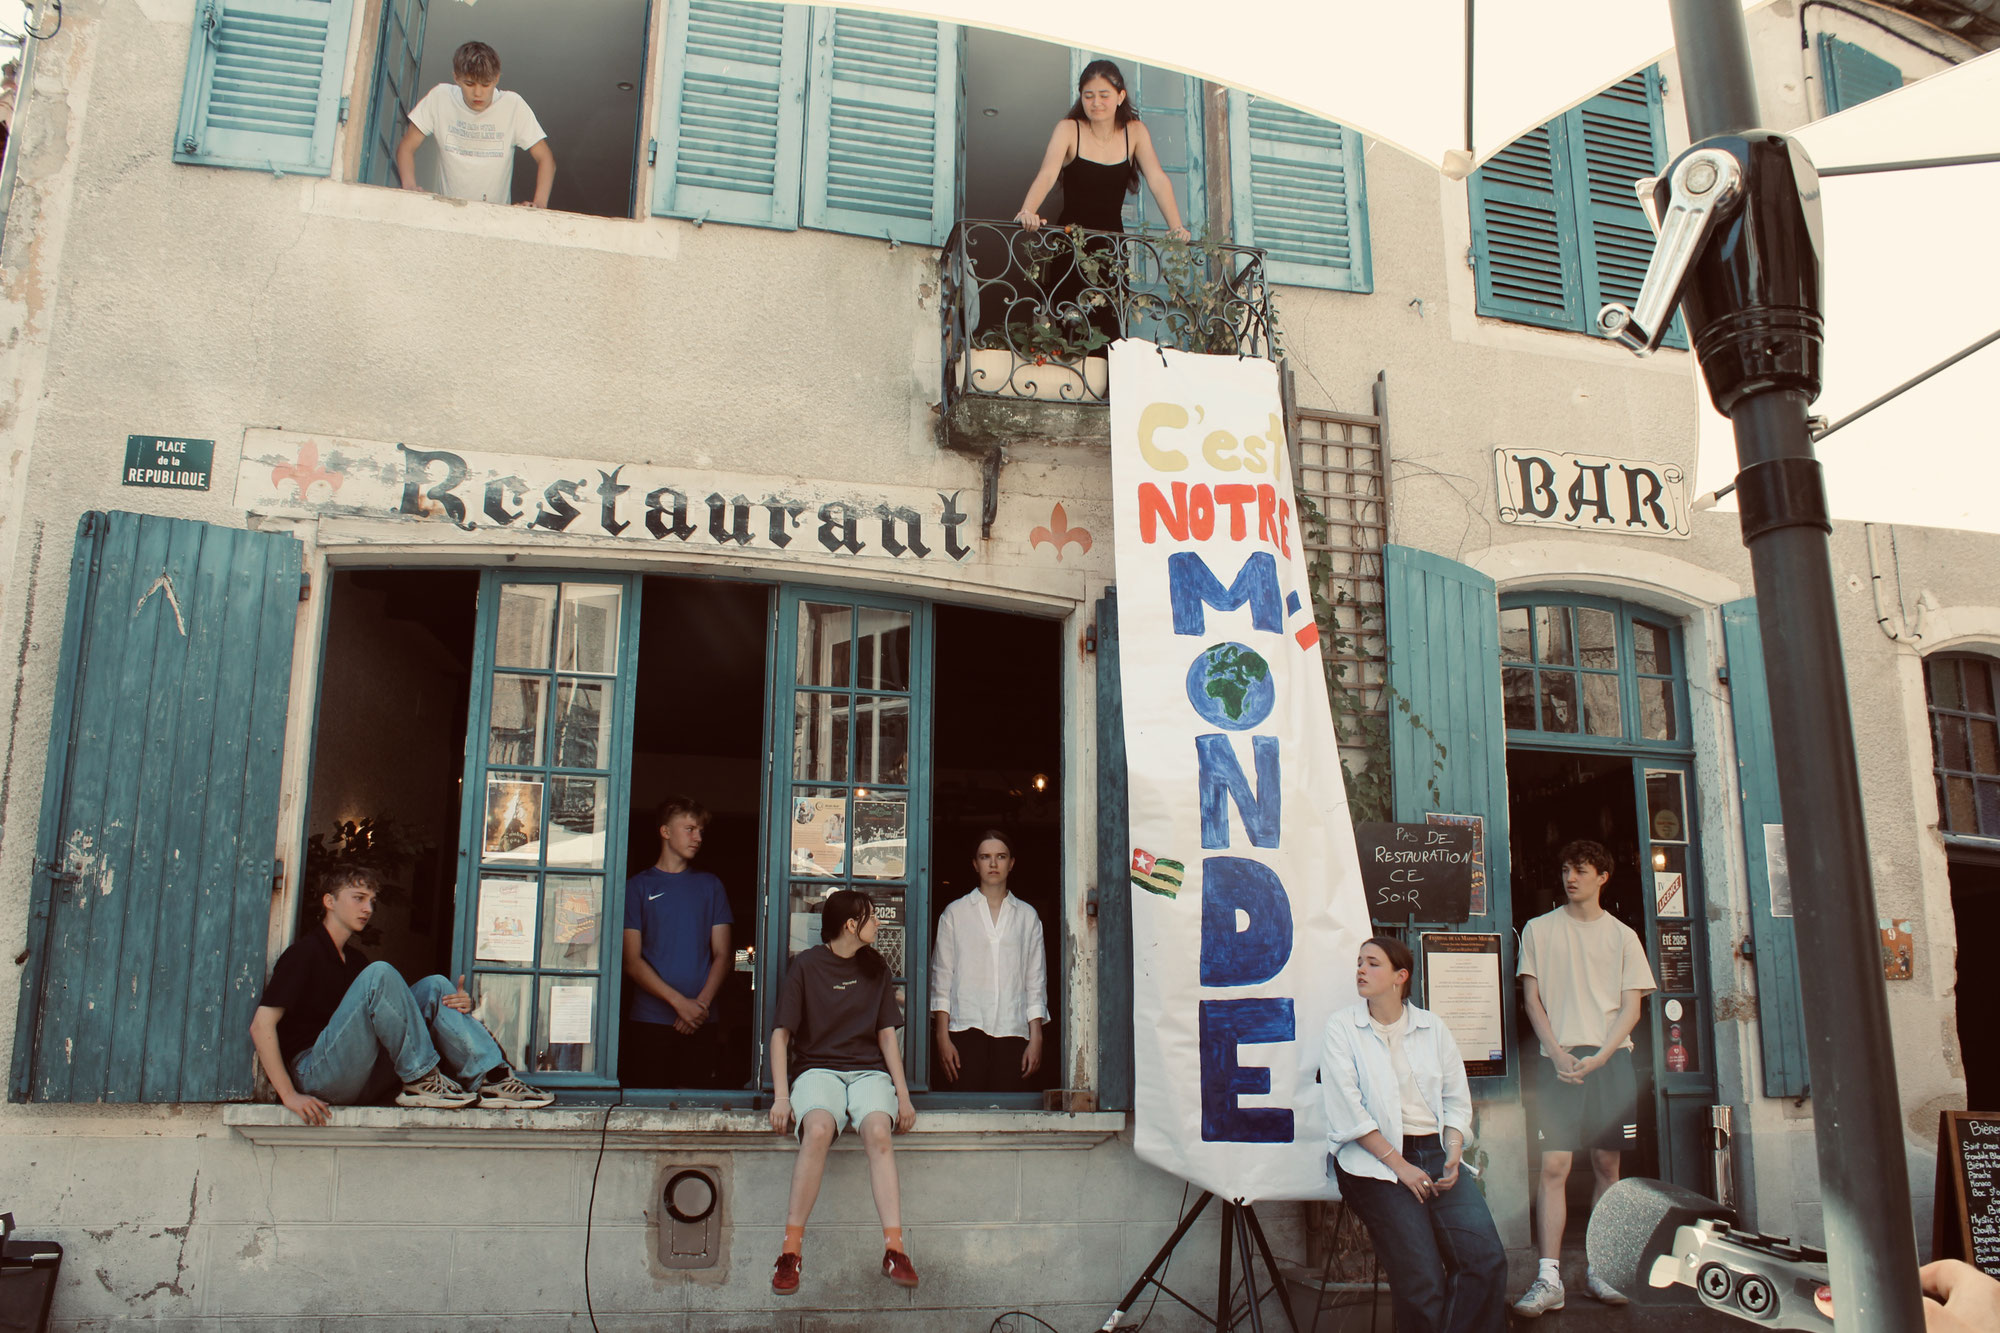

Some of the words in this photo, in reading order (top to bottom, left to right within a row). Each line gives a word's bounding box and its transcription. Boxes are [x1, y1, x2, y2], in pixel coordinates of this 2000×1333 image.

[156, 440, 187, 453] PLACE
[1137, 401, 1285, 482] C'est
[157, 455, 169, 465] de
[171, 456, 181, 467] la
[128, 467, 206, 487] REPUBLIQUE
[1512, 454, 1670, 530] BAR
[391, 442, 976, 561] Restaurant
[1137, 481, 1292, 561] NOTRE
[1396, 826, 1419, 843] PAS
[1424, 831, 1455, 845] DE
[1375, 845, 1473, 864] RESTAURATION
[1389, 869, 1425, 882] CE
[1659, 880, 1680, 908] LICENCE
[875, 906, 897, 919] 2025
[1662, 932, 1672, 946] ÉTÉ
[1672, 935, 1688, 946] 2025
[1887, 928, 1897, 941] 9
[1969, 1120, 2000, 1136] Bière
[1970, 1180, 1992, 1188] Monaco
[1971, 1213, 1994, 1227] Mystic
